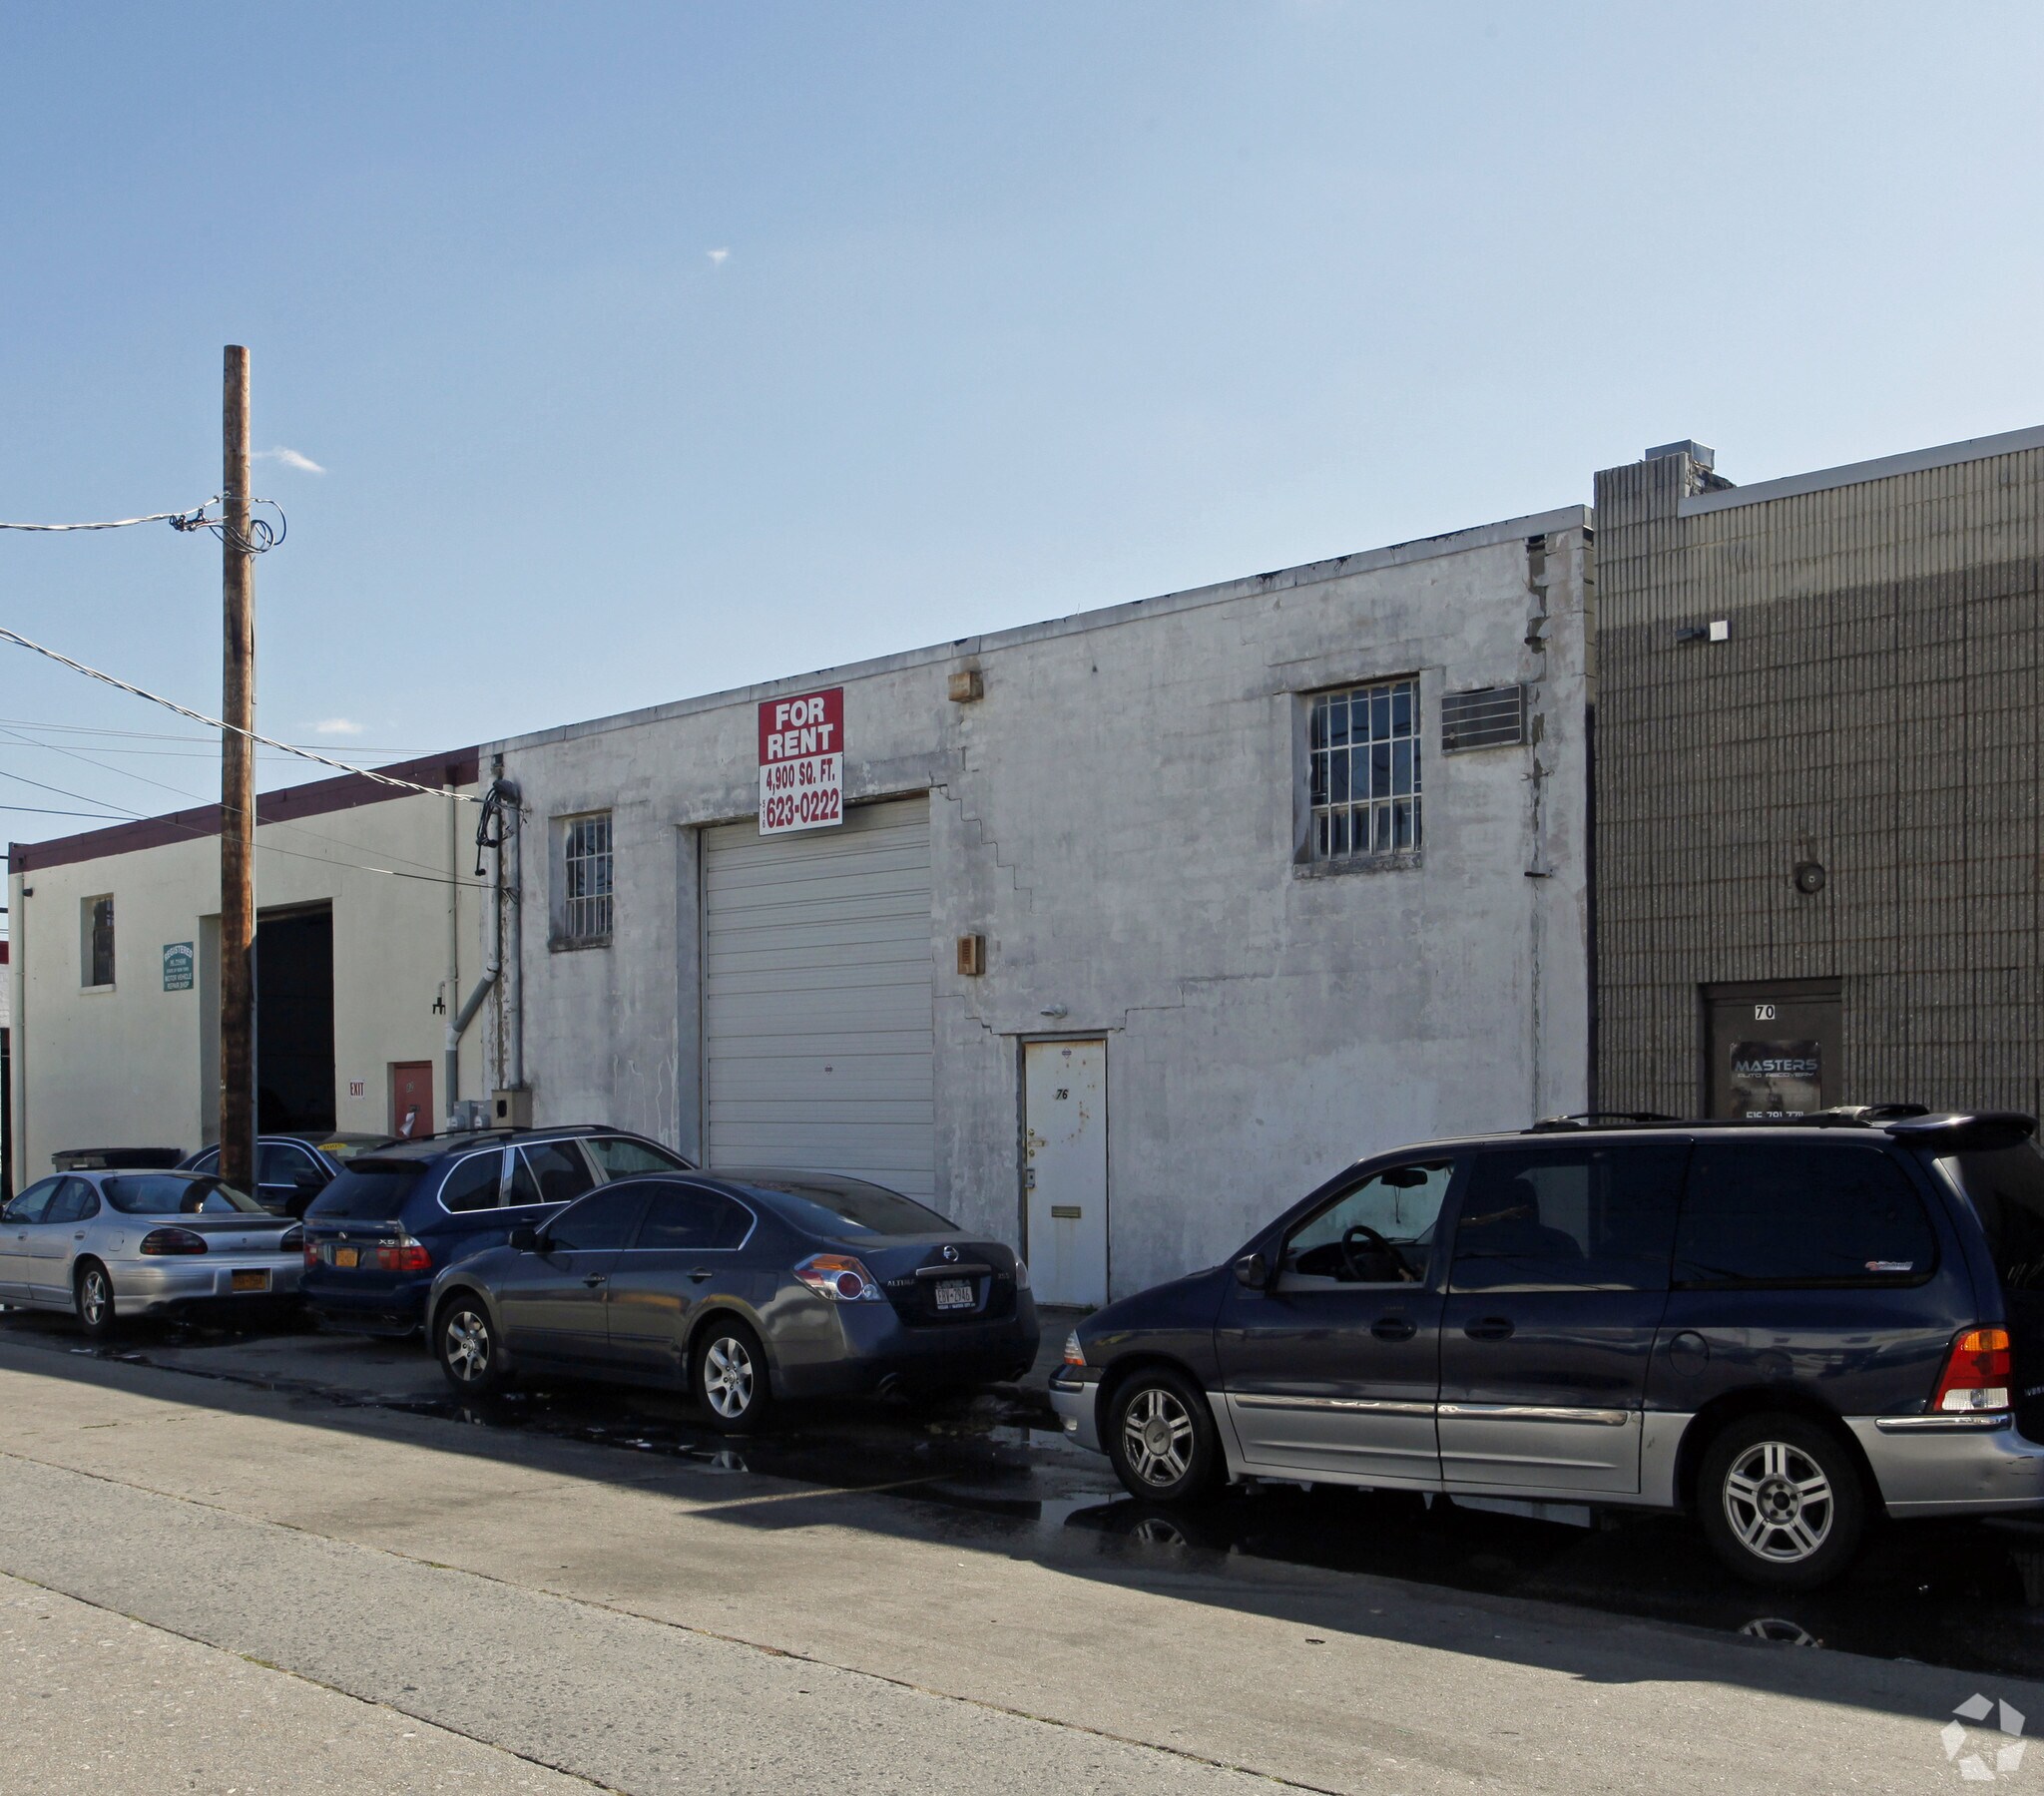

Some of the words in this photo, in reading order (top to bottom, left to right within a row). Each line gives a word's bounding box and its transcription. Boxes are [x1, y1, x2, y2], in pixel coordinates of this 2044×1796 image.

[775, 696, 824, 731] FOR
[767, 723, 833, 760] RENT
[766, 763, 795, 795] 4,900
[798, 761, 816, 786] SQ.
[820, 757, 835, 783] FT.
[766, 787, 839, 829] 623-0222
[165, 945, 193, 963] REGISTERED
[1757, 1006, 1774, 1019] 70
[1735, 1059, 1817, 1072] MASTERS
[350, 1082, 363, 1096] EXIT
[1056, 1089, 1069, 1100] 76
